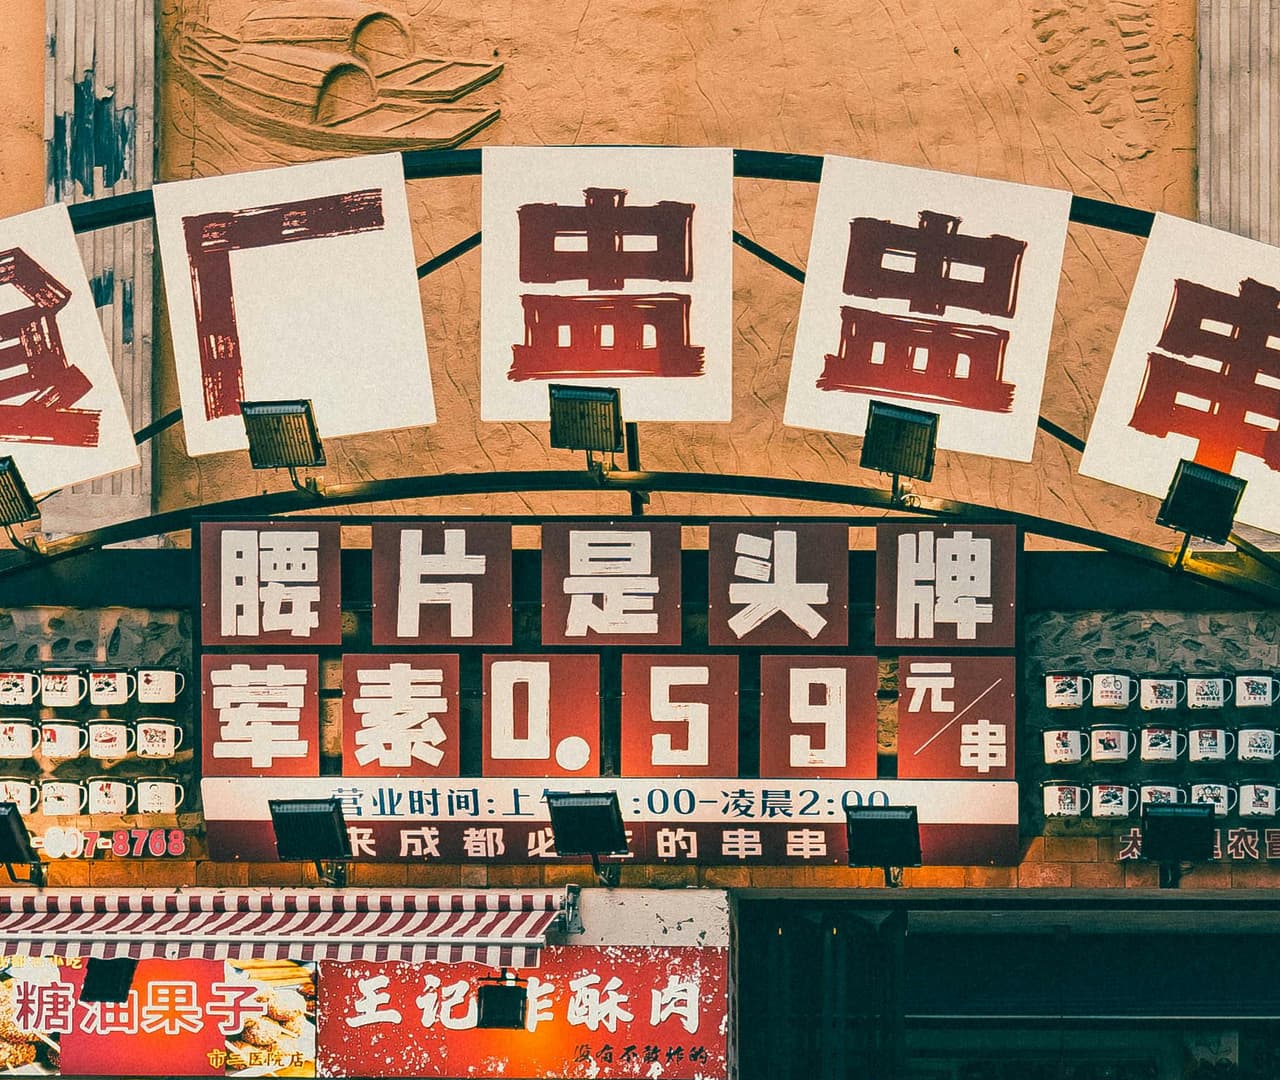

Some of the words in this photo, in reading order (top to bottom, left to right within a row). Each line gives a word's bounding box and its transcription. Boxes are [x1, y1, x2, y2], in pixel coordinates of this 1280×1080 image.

[221, 529, 995, 641] 腰片是头牌
[345, 826, 828, 859] 来成都必的串串
[16, 979, 268, 1035] 糖油果子
